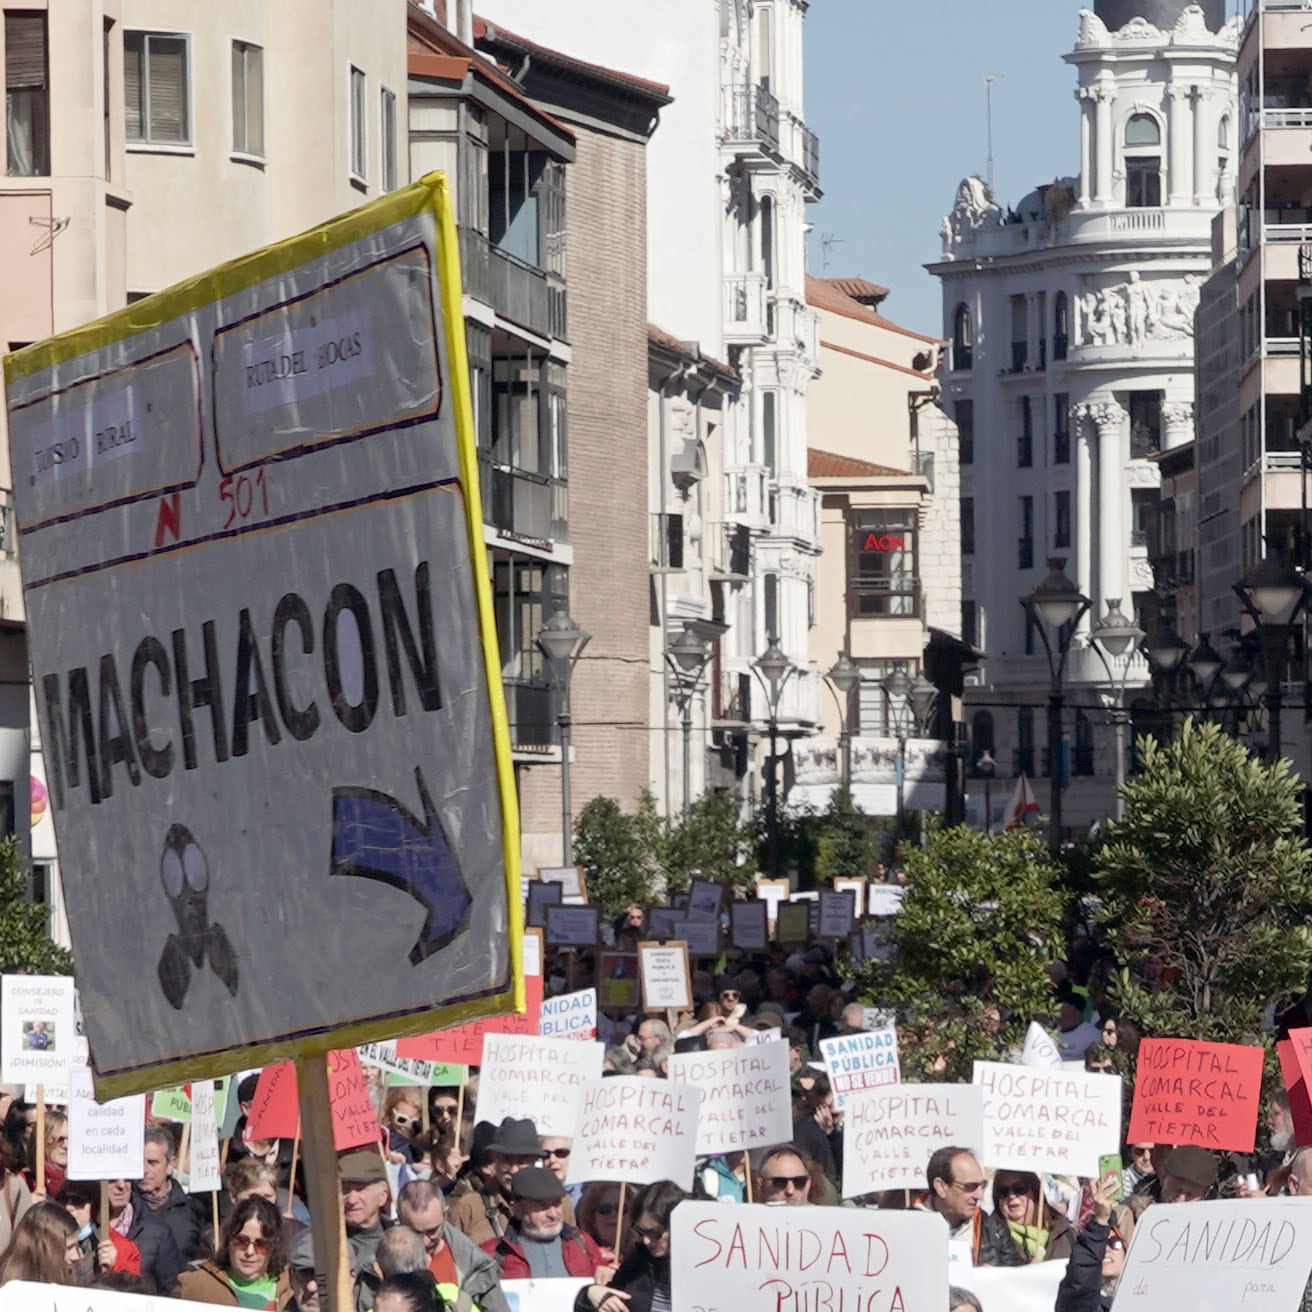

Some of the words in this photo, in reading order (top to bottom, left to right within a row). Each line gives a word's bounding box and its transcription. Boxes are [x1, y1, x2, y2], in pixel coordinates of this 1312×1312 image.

[155, 494, 181, 547] N
[43, 560, 443, 809] MACHACON
[17, 1007, 59, 1016] SANIDAD
[826, 1033, 894, 1056] SANIDAD
[673, 1056, 771, 1083] HOSPITAL
[831, 1051, 896, 1074] PÚBLICA
[1143, 1045, 1239, 1073] HOSPITAL
[700, 1077, 784, 1104] MARCAL
[980, 1069, 1100, 1099] HOSPITAL
[1140, 1076, 1248, 1102] COMARCAL
[87, 1106, 125, 1118] calidad
[583, 1086, 686, 1115] HOSPITAL
[852, 1093, 958, 1128] HOSPITAL
[983, 1100, 1108, 1127] COMARCAL
[1144, 1102, 1184, 1115] VALLE
[1197, 1104, 1228, 1117] DEL
[85, 1127, 99, 1137] en
[100, 1126, 126, 1137] cada
[581, 1113, 684, 1138] COMARCAL
[855, 1124, 956, 1151] COMARCAL
[992, 1126, 1047, 1138] VALLE
[1052, 1129, 1081, 1142] DEL
[81, 1143, 129, 1155] localidad
[692, 1218, 890, 1278] SANIDAD
[1139, 1218, 1296, 1266] SANIDAD
[1133, 1279, 1150, 1296] de
[1241, 1282, 1277, 1302] para
